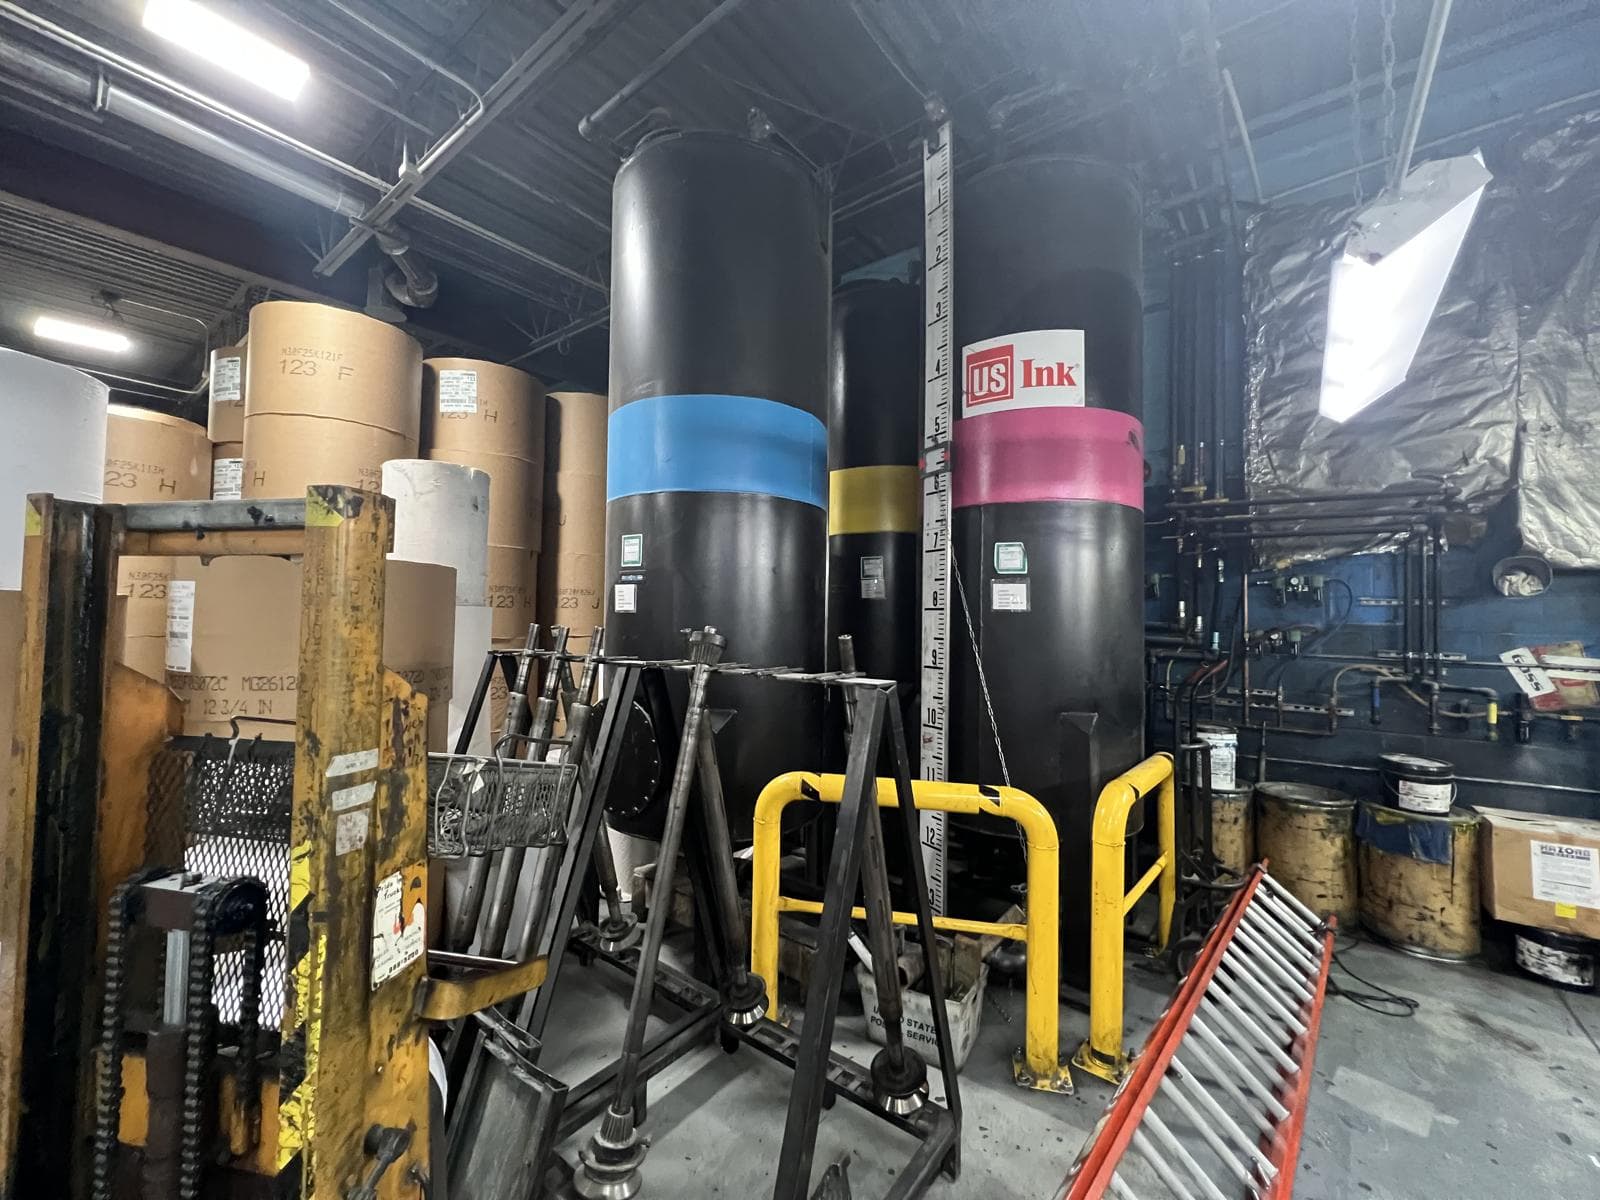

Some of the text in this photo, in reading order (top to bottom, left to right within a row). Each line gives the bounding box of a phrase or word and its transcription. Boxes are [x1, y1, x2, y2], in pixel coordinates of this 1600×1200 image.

[935, 245, 942, 262] 2
[935, 301, 942, 318] 3
[279, 359, 354, 380] 123 F
[935, 359, 941, 375] 4
[973, 358, 1077, 396] US Ink
[484, 409, 499, 424] H
[934, 416, 940, 433] 5
[104, 471, 176, 494] 23 H
[253, 471, 266, 487] H
[933, 532, 939, 548] 7
[127, 583, 168, 599] 123
[932, 591, 938, 607] 8
[488, 595, 514, 609] 123
[560, 597, 601, 610] 23 J
[931, 649, 938, 665] 9
[490, 686, 508, 700] 23
[258, 699, 273, 715] IN
[927, 707, 937, 725] 10
[926, 766, 935, 782] 11
[926, 826, 935, 845] 12
[928, 889, 935, 905] 3
[906, 1018, 937, 1035] STATE
[906, 1030, 937, 1046] SERVI
